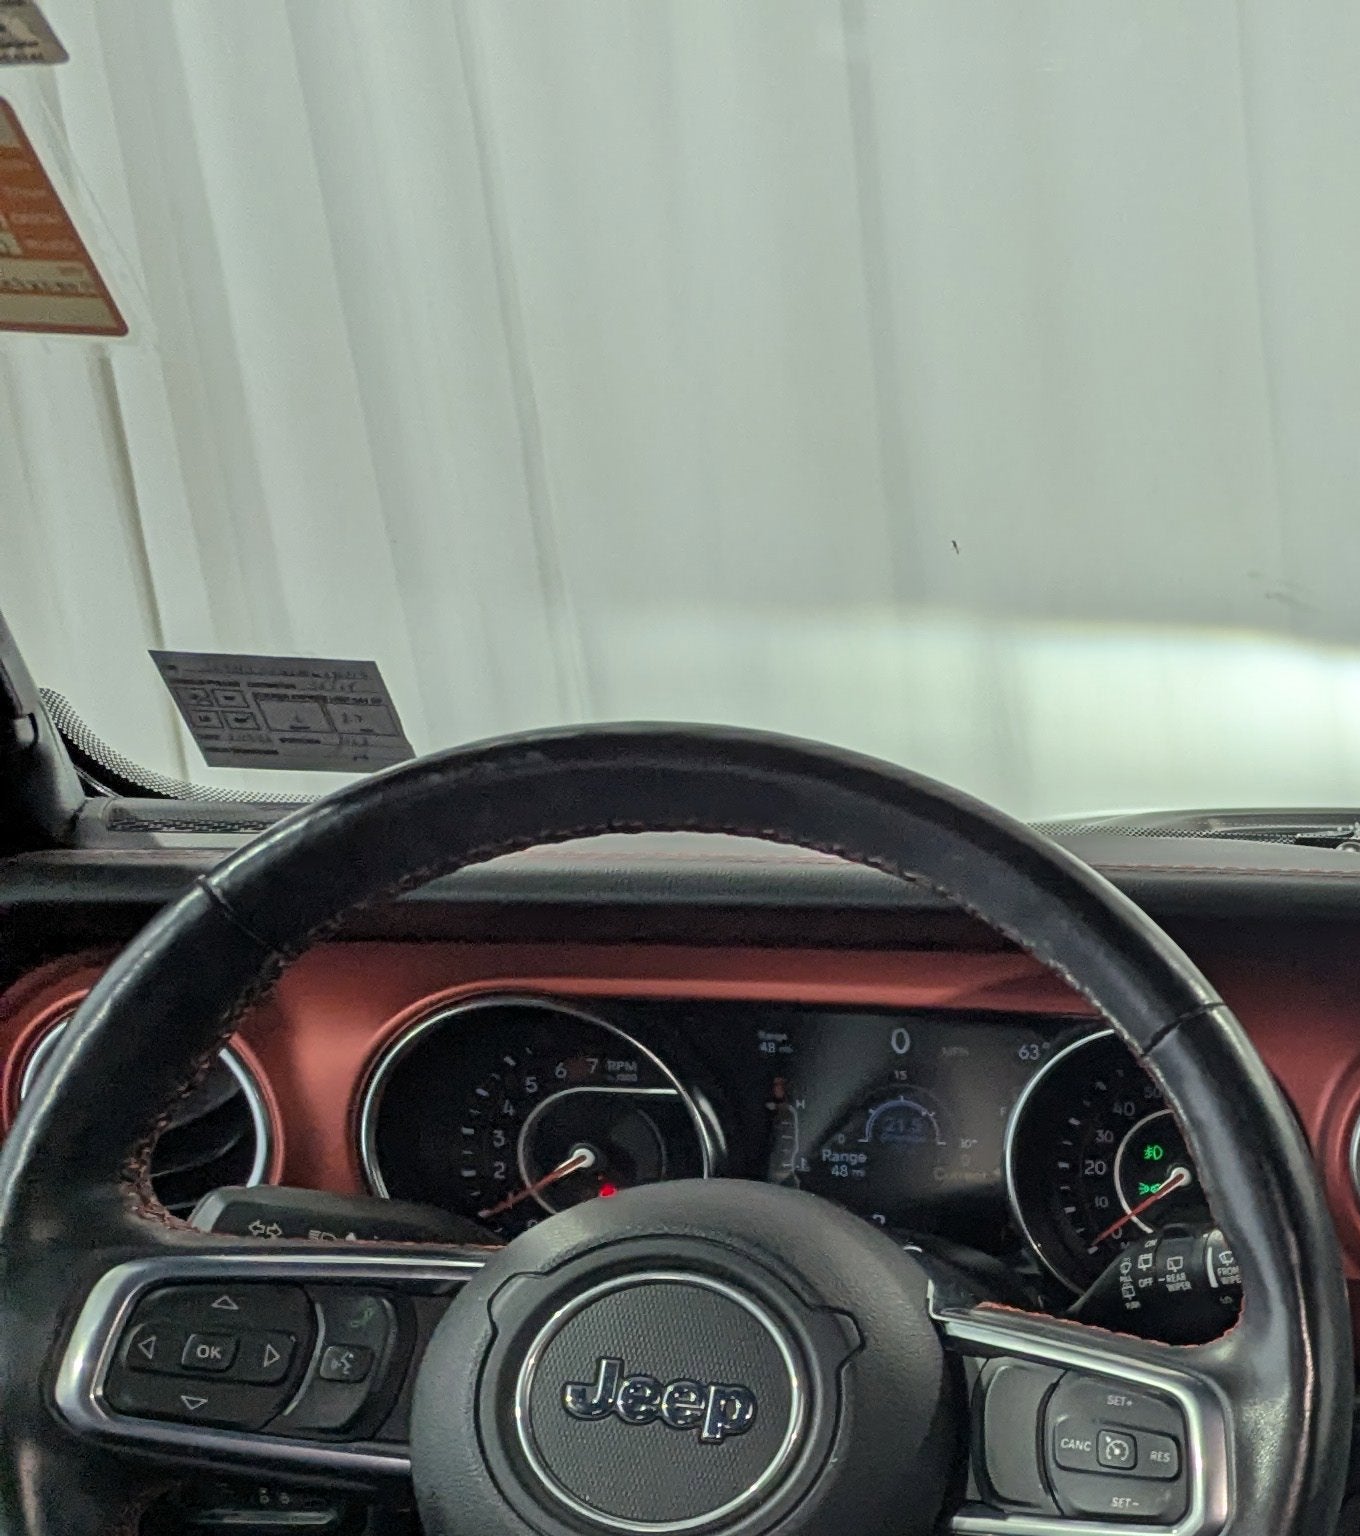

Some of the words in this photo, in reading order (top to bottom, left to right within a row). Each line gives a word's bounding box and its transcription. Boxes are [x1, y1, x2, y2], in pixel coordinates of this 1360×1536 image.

[890, 1027, 911, 1055] 0
[554, 1062, 567, 1079] 6
[585, 1058, 598, 1074] 7
[607, 1060, 637, 1071] RPM
[525, 1076, 538, 1093] 5
[503, 1100, 514, 1116] 4
[1113, 1102, 1136, 1117] 40
[493, 1130, 505, 1148] 3
[1095, 1129, 1114, 1143] 30
[822, 1148, 868, 1166] Range
[493, 1161, 505, 1179] 2
[831, 1164, 849, 1178] 48
[1084, 1160, 1106, 1175] 20
[1095, 1196, 1108, 1208] 10
[1138, 1277, 1153, 1288] OFF
[1166, 1272, 1186, 1283] REAR
[196, 1343, 222, 1360] OK
[563, 1357, 757, 1444] Jeep
[1060, 1438, 1092, 1451] CANC
[1149, 1451, 1171, 1463] RES
